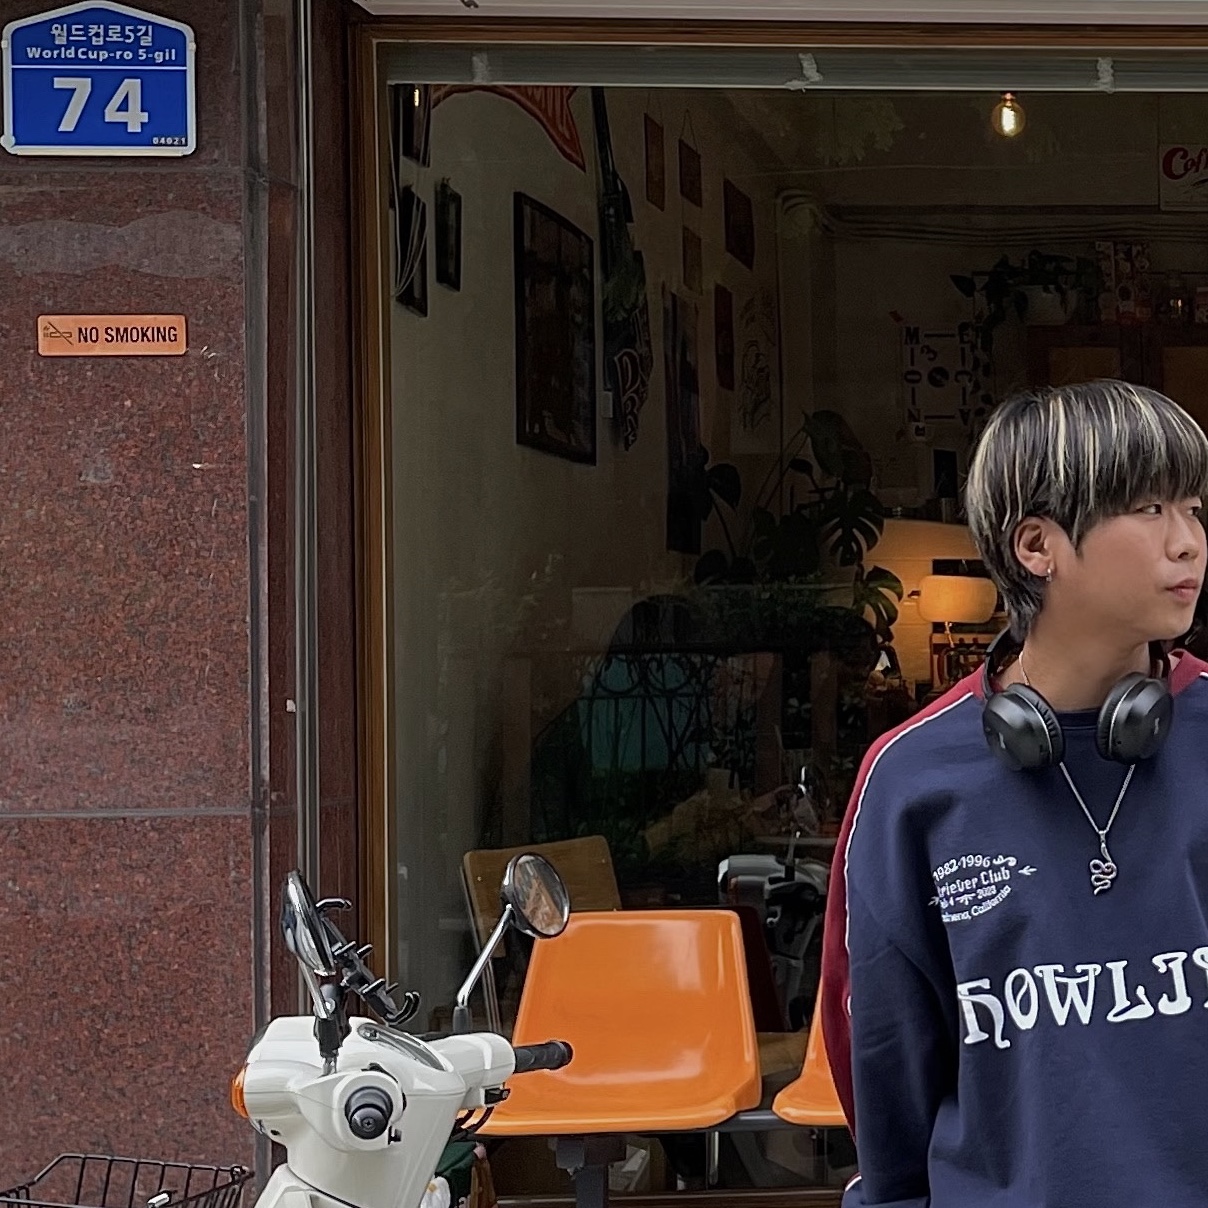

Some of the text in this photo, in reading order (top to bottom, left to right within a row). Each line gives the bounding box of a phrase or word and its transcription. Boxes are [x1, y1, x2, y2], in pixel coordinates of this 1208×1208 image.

[50, 23, 153, 46] 월드컵로5길
[138, 48, 176, 63] 5-gil
[53, 76, 149, 132] 74
[78, 326, 178, 344] NO SMOKING
[979, 866, 1011, 886] Club
